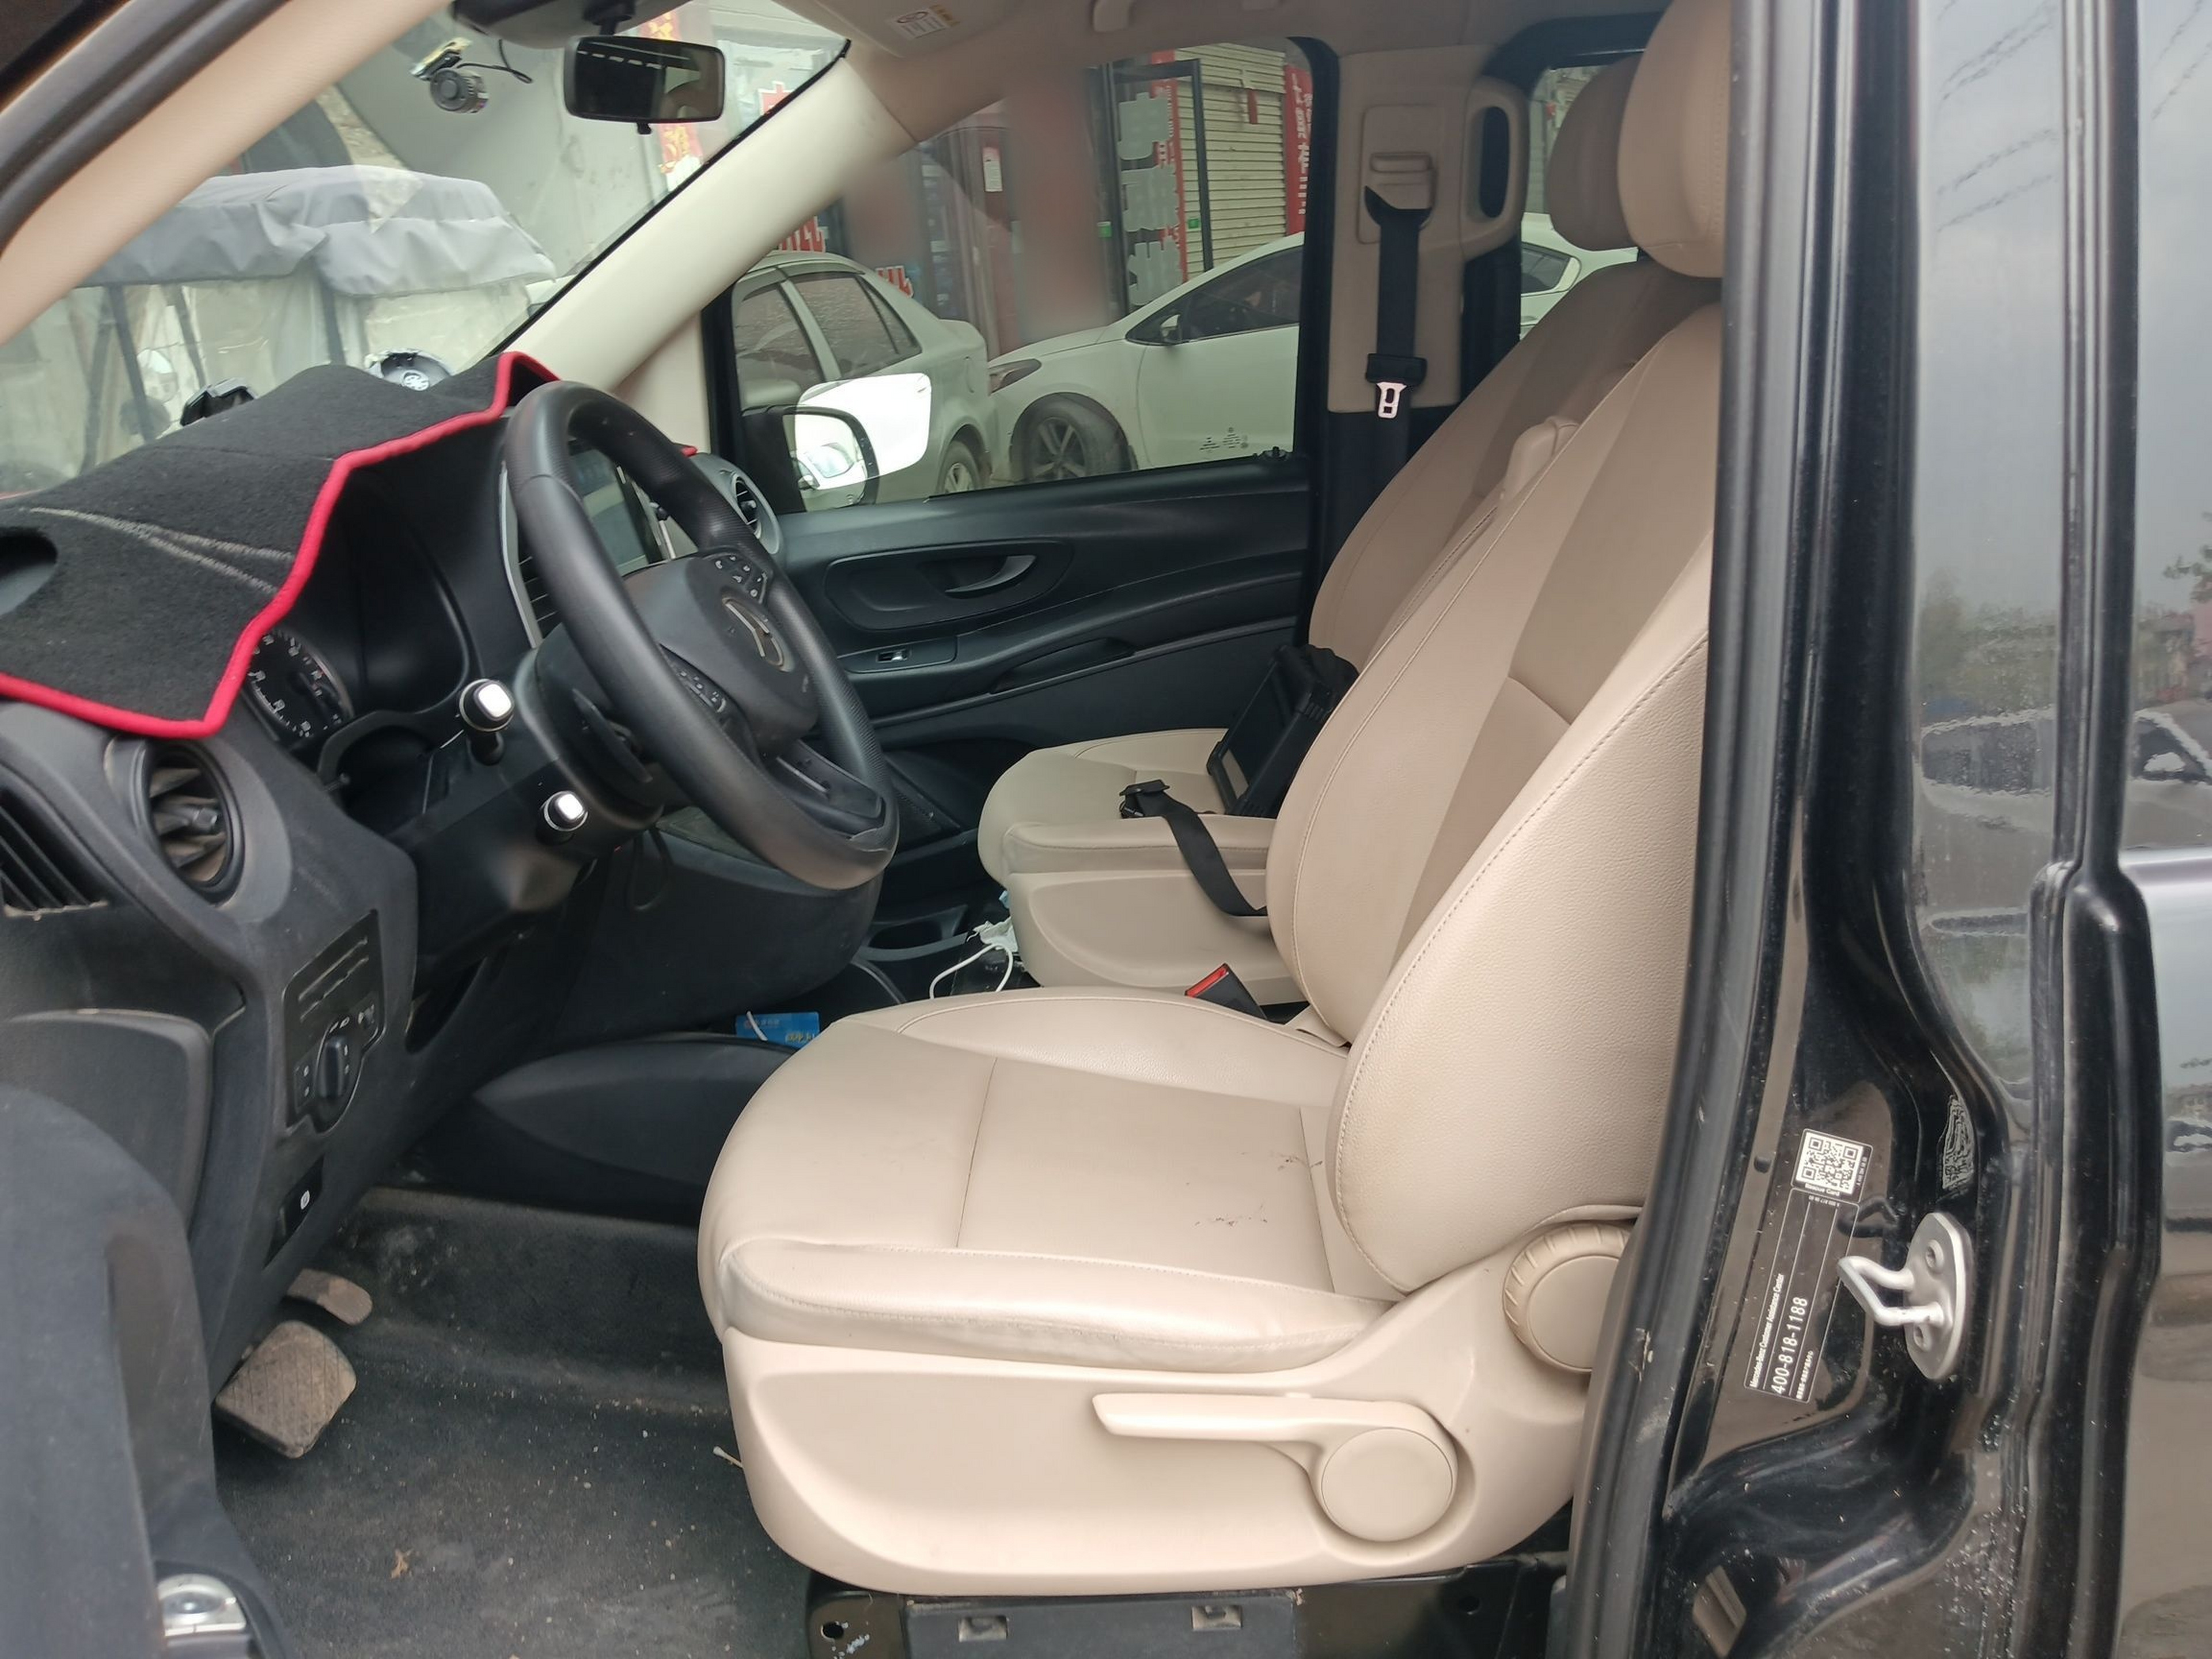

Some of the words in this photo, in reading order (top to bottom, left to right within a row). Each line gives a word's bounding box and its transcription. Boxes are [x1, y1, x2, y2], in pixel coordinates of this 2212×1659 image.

[1749, 1347, 1764, 1388] Mercedes-Benz
[1759, 1321, 1772, 1349] Customer
[1766, 1291, 1779, 1322] Assistance
[1773, 1272, 1785, 1292] Center
[1771, 1297, 1808, 1394] 400-818-1188
